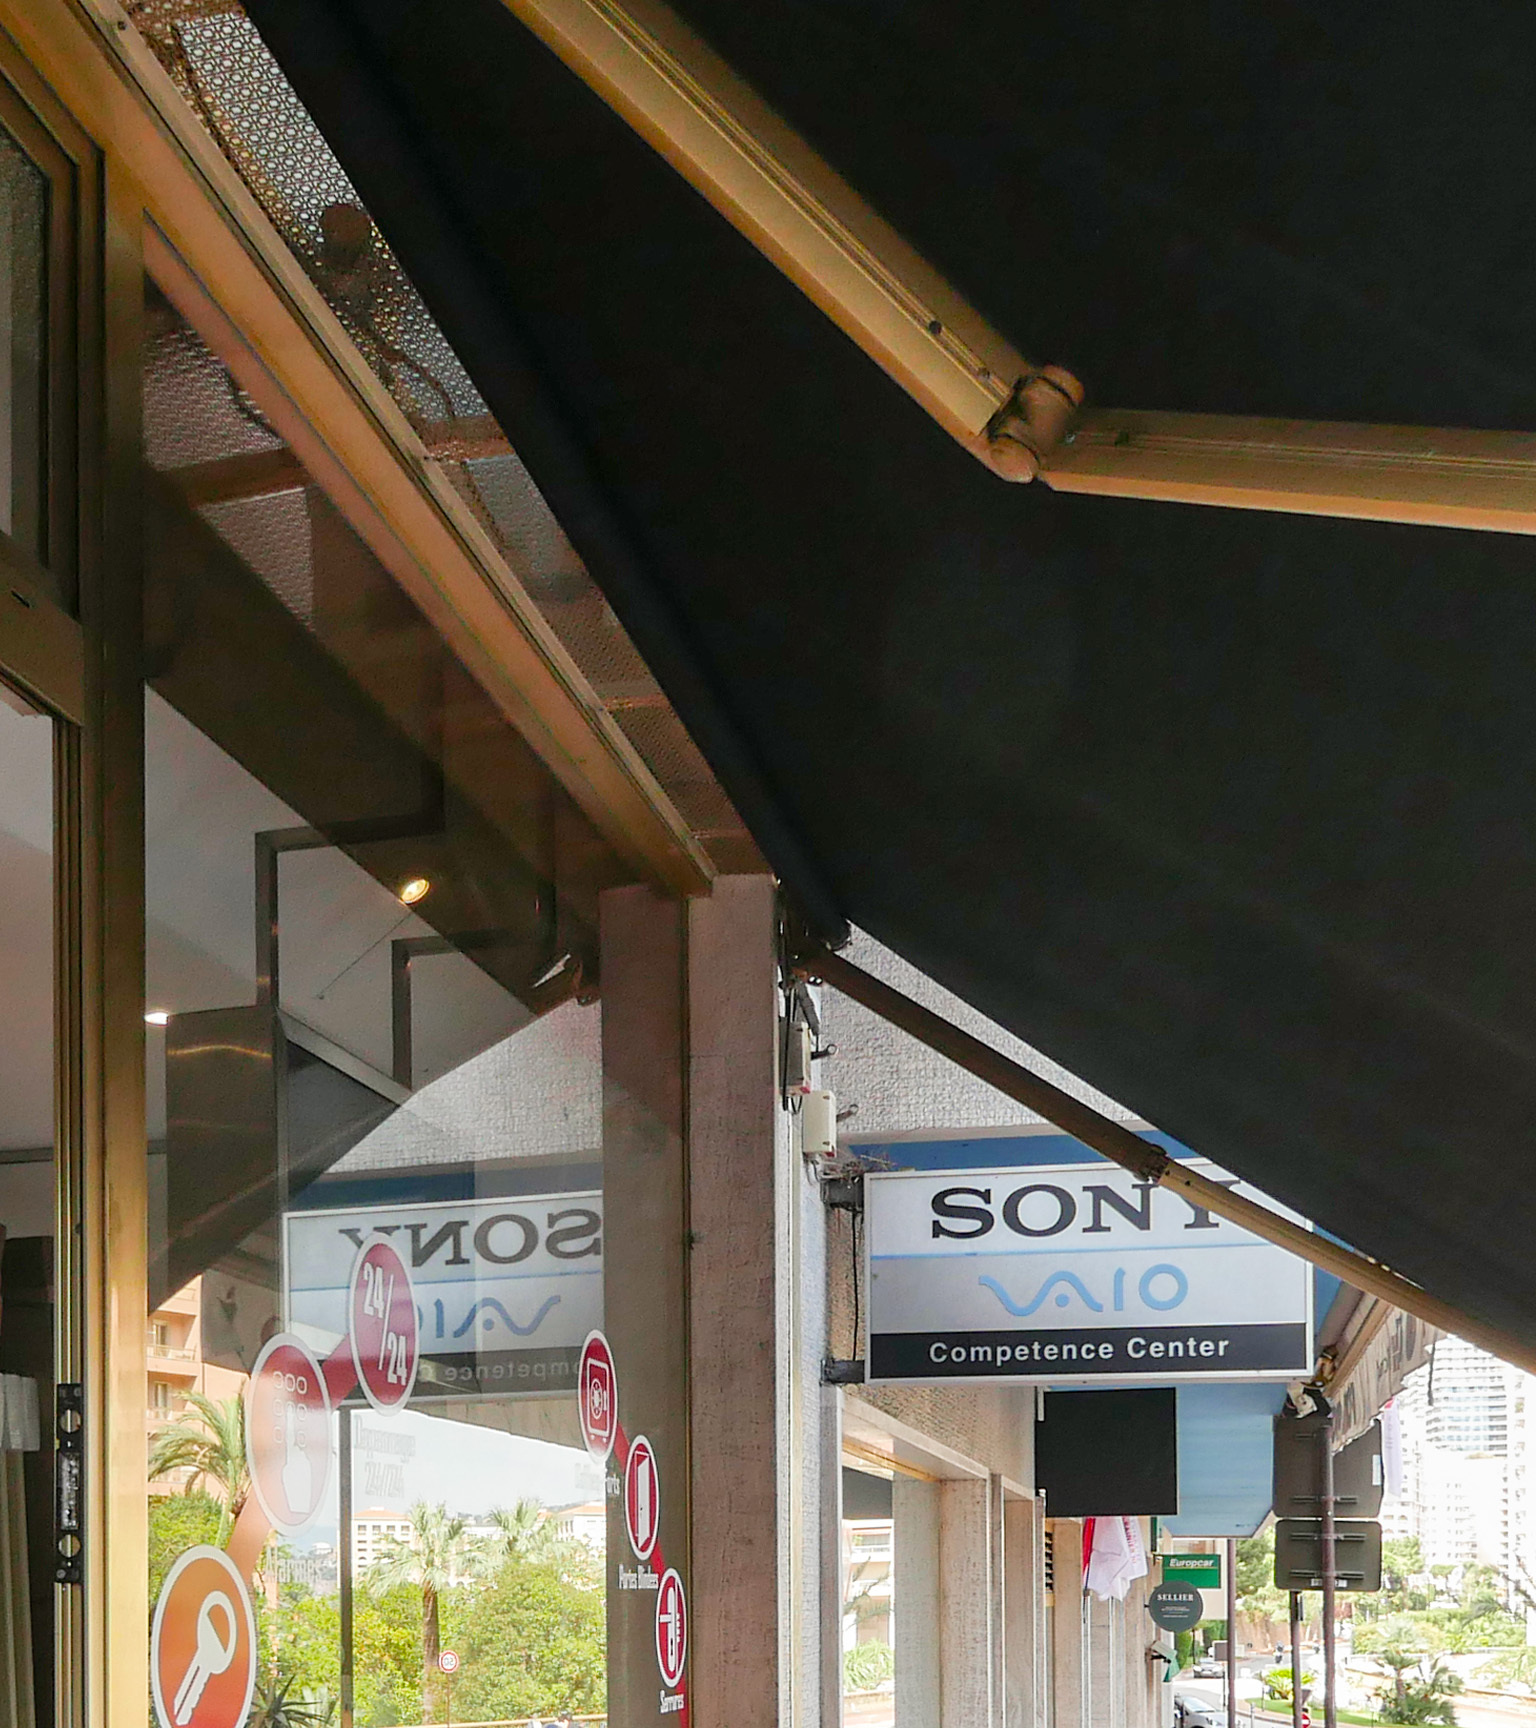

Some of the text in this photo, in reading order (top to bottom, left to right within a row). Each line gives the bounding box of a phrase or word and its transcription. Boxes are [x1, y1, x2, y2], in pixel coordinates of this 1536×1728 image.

[979, 1263, 1189, 1317] VAIO
[929, 1336, 1230, 1368] Competence Center
[1169, 1558, 1214, 1569] Europcar
[1156, 1593, 1194, 1602] SELLIER
